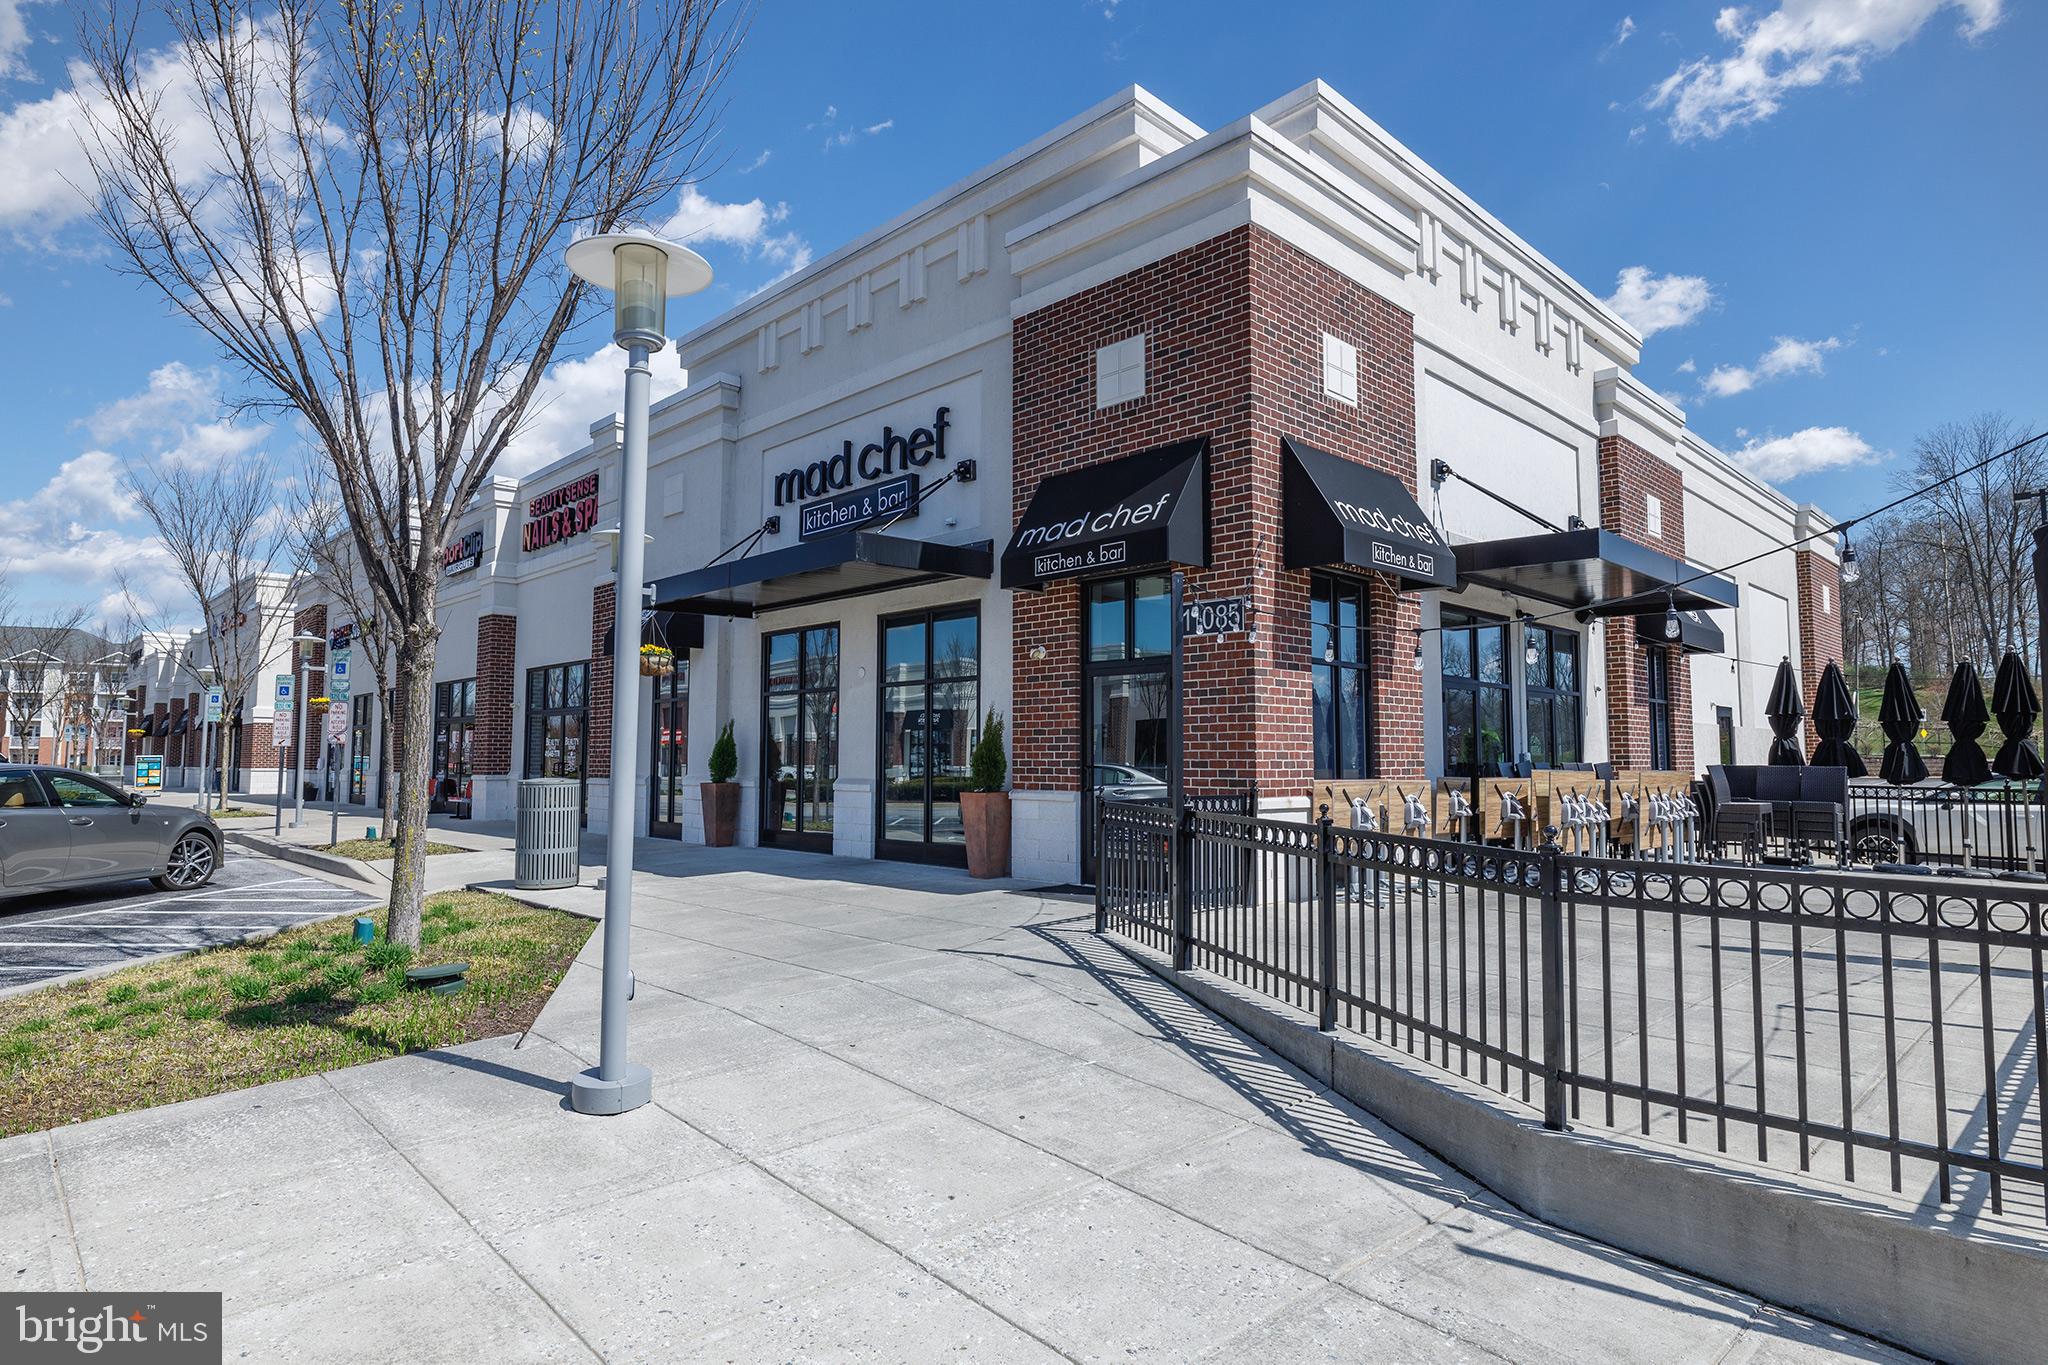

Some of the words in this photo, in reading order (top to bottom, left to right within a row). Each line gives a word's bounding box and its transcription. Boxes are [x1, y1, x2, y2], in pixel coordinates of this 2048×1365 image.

[775, 440, 853, 506] mad
[858, 407, 951, 480] chef
[529, 488, 565, 517] BEAUTY
[565, 475, 597, 501] SENSE
[806, 503, 857, 530] kitchen
[862, 498, 873, 516] &
[878, 488, 904, 511] bar
[523, 511, 560, 552] NAILS
[562, 505, 572, 538] &
[1017, 511, 1091, 548] mad
[1091, 493, 1170, 533] chef
[1334, 500, 1394, 533] mad
[1391, 514, 1440, 546] chef
[1038, 552, 1082, 574] kitchen
[1087, 551, 1096, 564] &
[1100, 545, 1122, 562] bar
[1374, 546, 1407, 567] kitchen
[1409, 556, 1416, 569] &
[1417, 553, 1432, 572] bar
[1183, 603, 1240, 632] 1085
